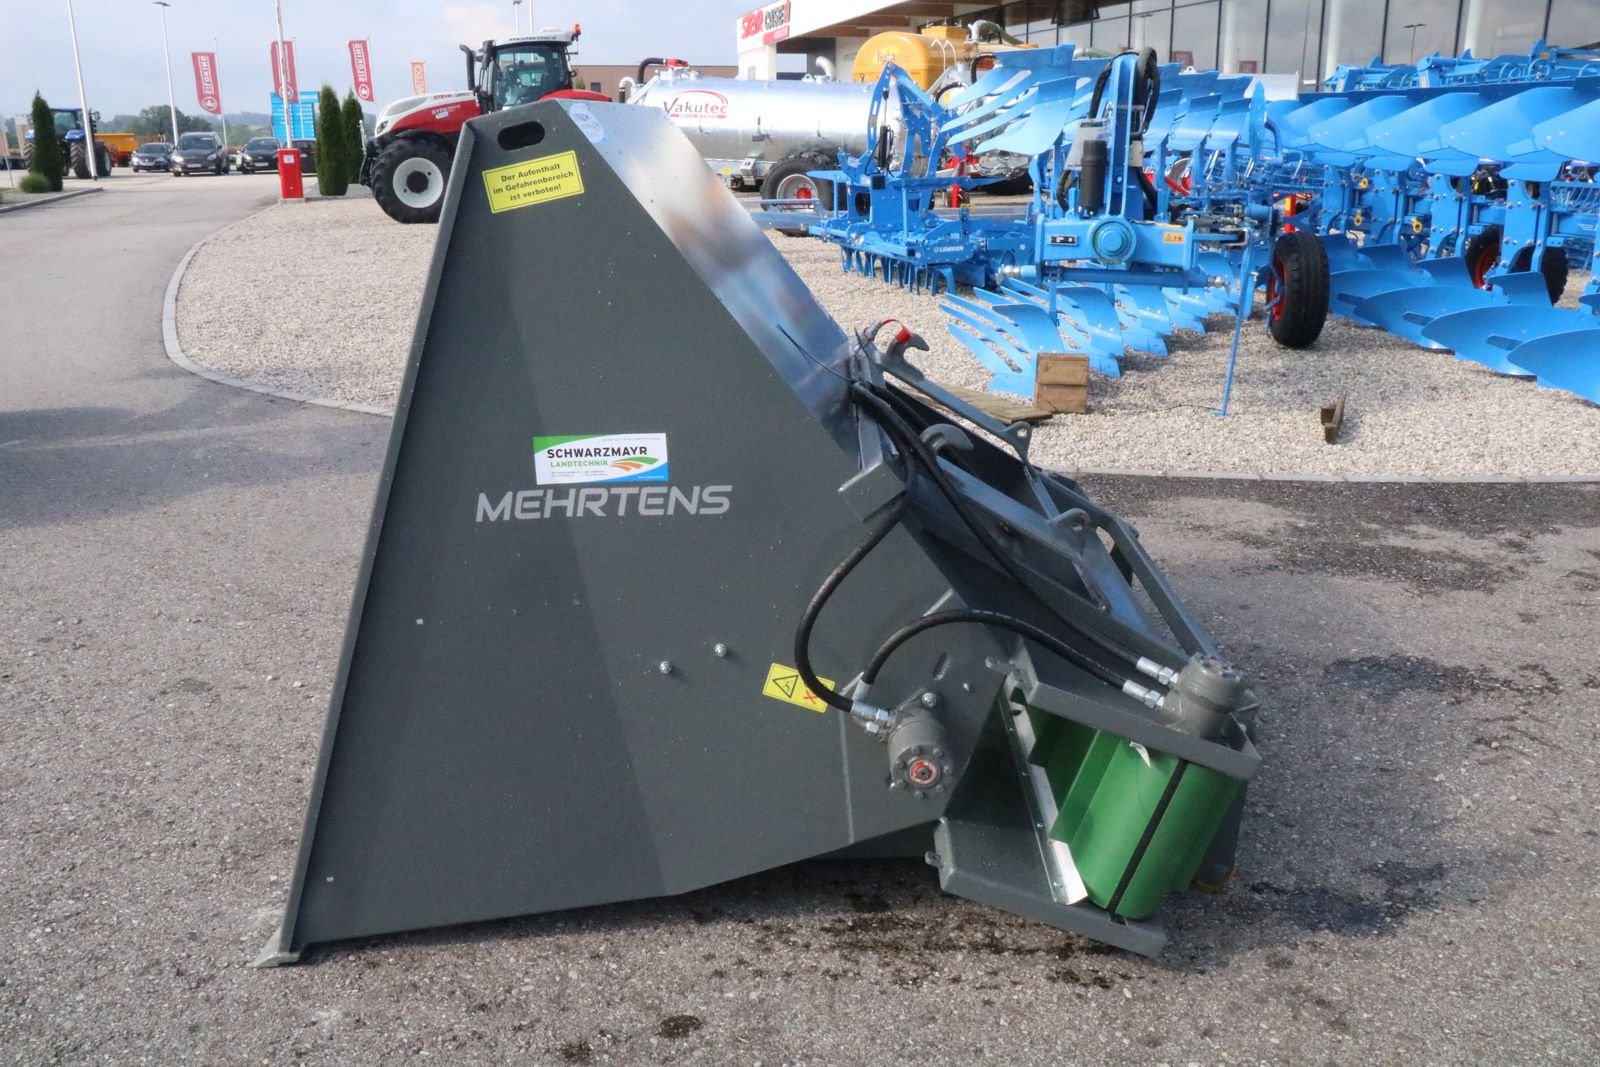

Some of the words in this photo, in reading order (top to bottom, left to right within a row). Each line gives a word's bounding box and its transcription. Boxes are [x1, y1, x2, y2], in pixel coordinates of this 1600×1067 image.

[663, 97, 728, 114] Vakutec
[501, 173, 516, 183] Der
[518, 162, 561, 179] Aufenthalt
[493, 187, 504, 195] im
[505, 170, 574, 192] Gefahrenbereich
[510, 191, 521, 201] ist
[523, 183, 562, 199] verboten!
[547, 446, 648, 459] SCHWARZMAYR
[550, 459, 609, 468] LANDTECHNIK
[475, 484, 733, 523] MEHRTENS
